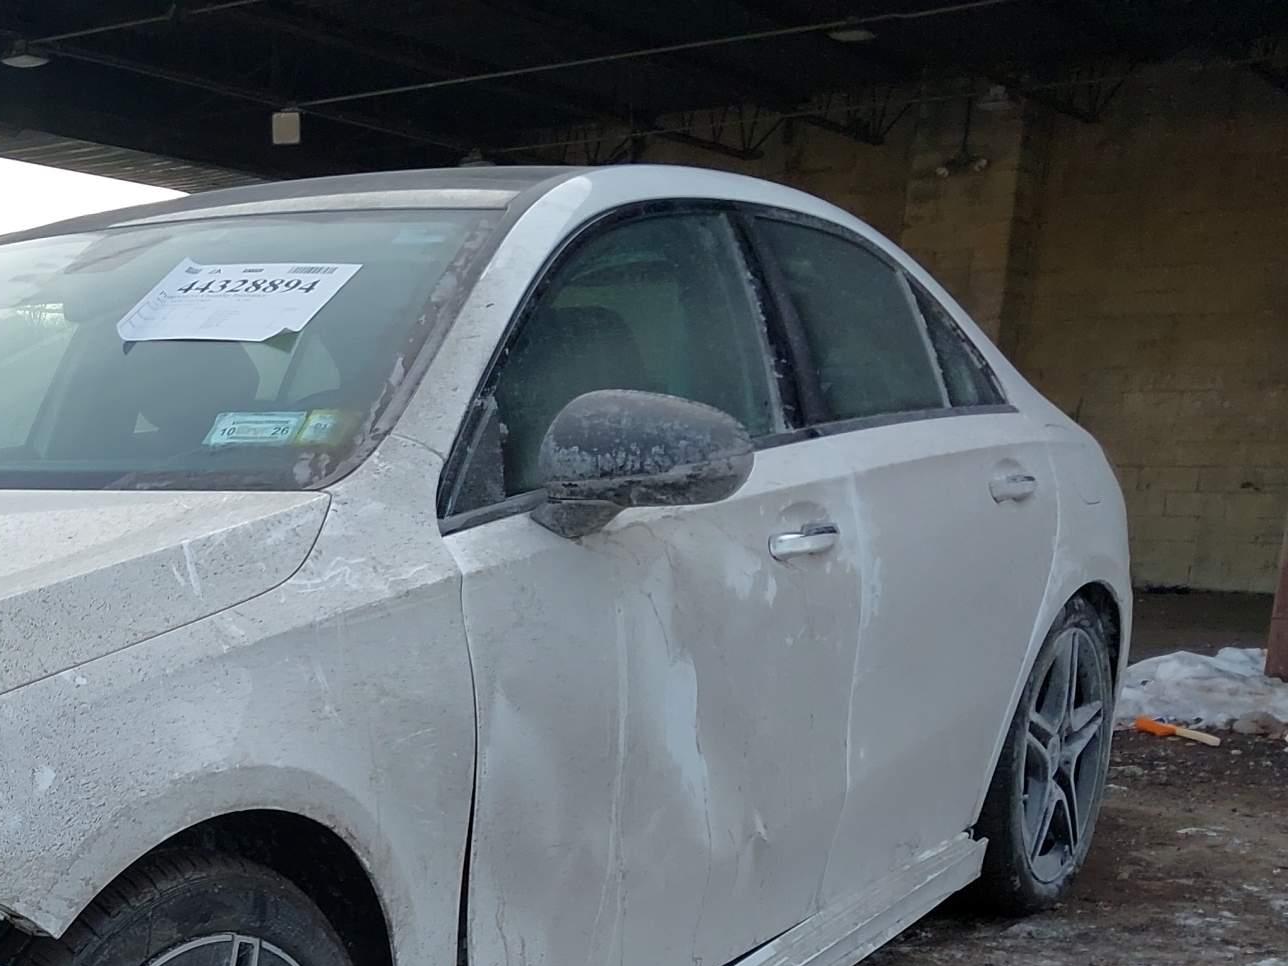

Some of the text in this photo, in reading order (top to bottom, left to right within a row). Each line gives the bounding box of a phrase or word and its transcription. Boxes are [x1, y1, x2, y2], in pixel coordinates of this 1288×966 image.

[177, 278, 321, 294] 44328894
[219, 426, 289, 437] 10 26
